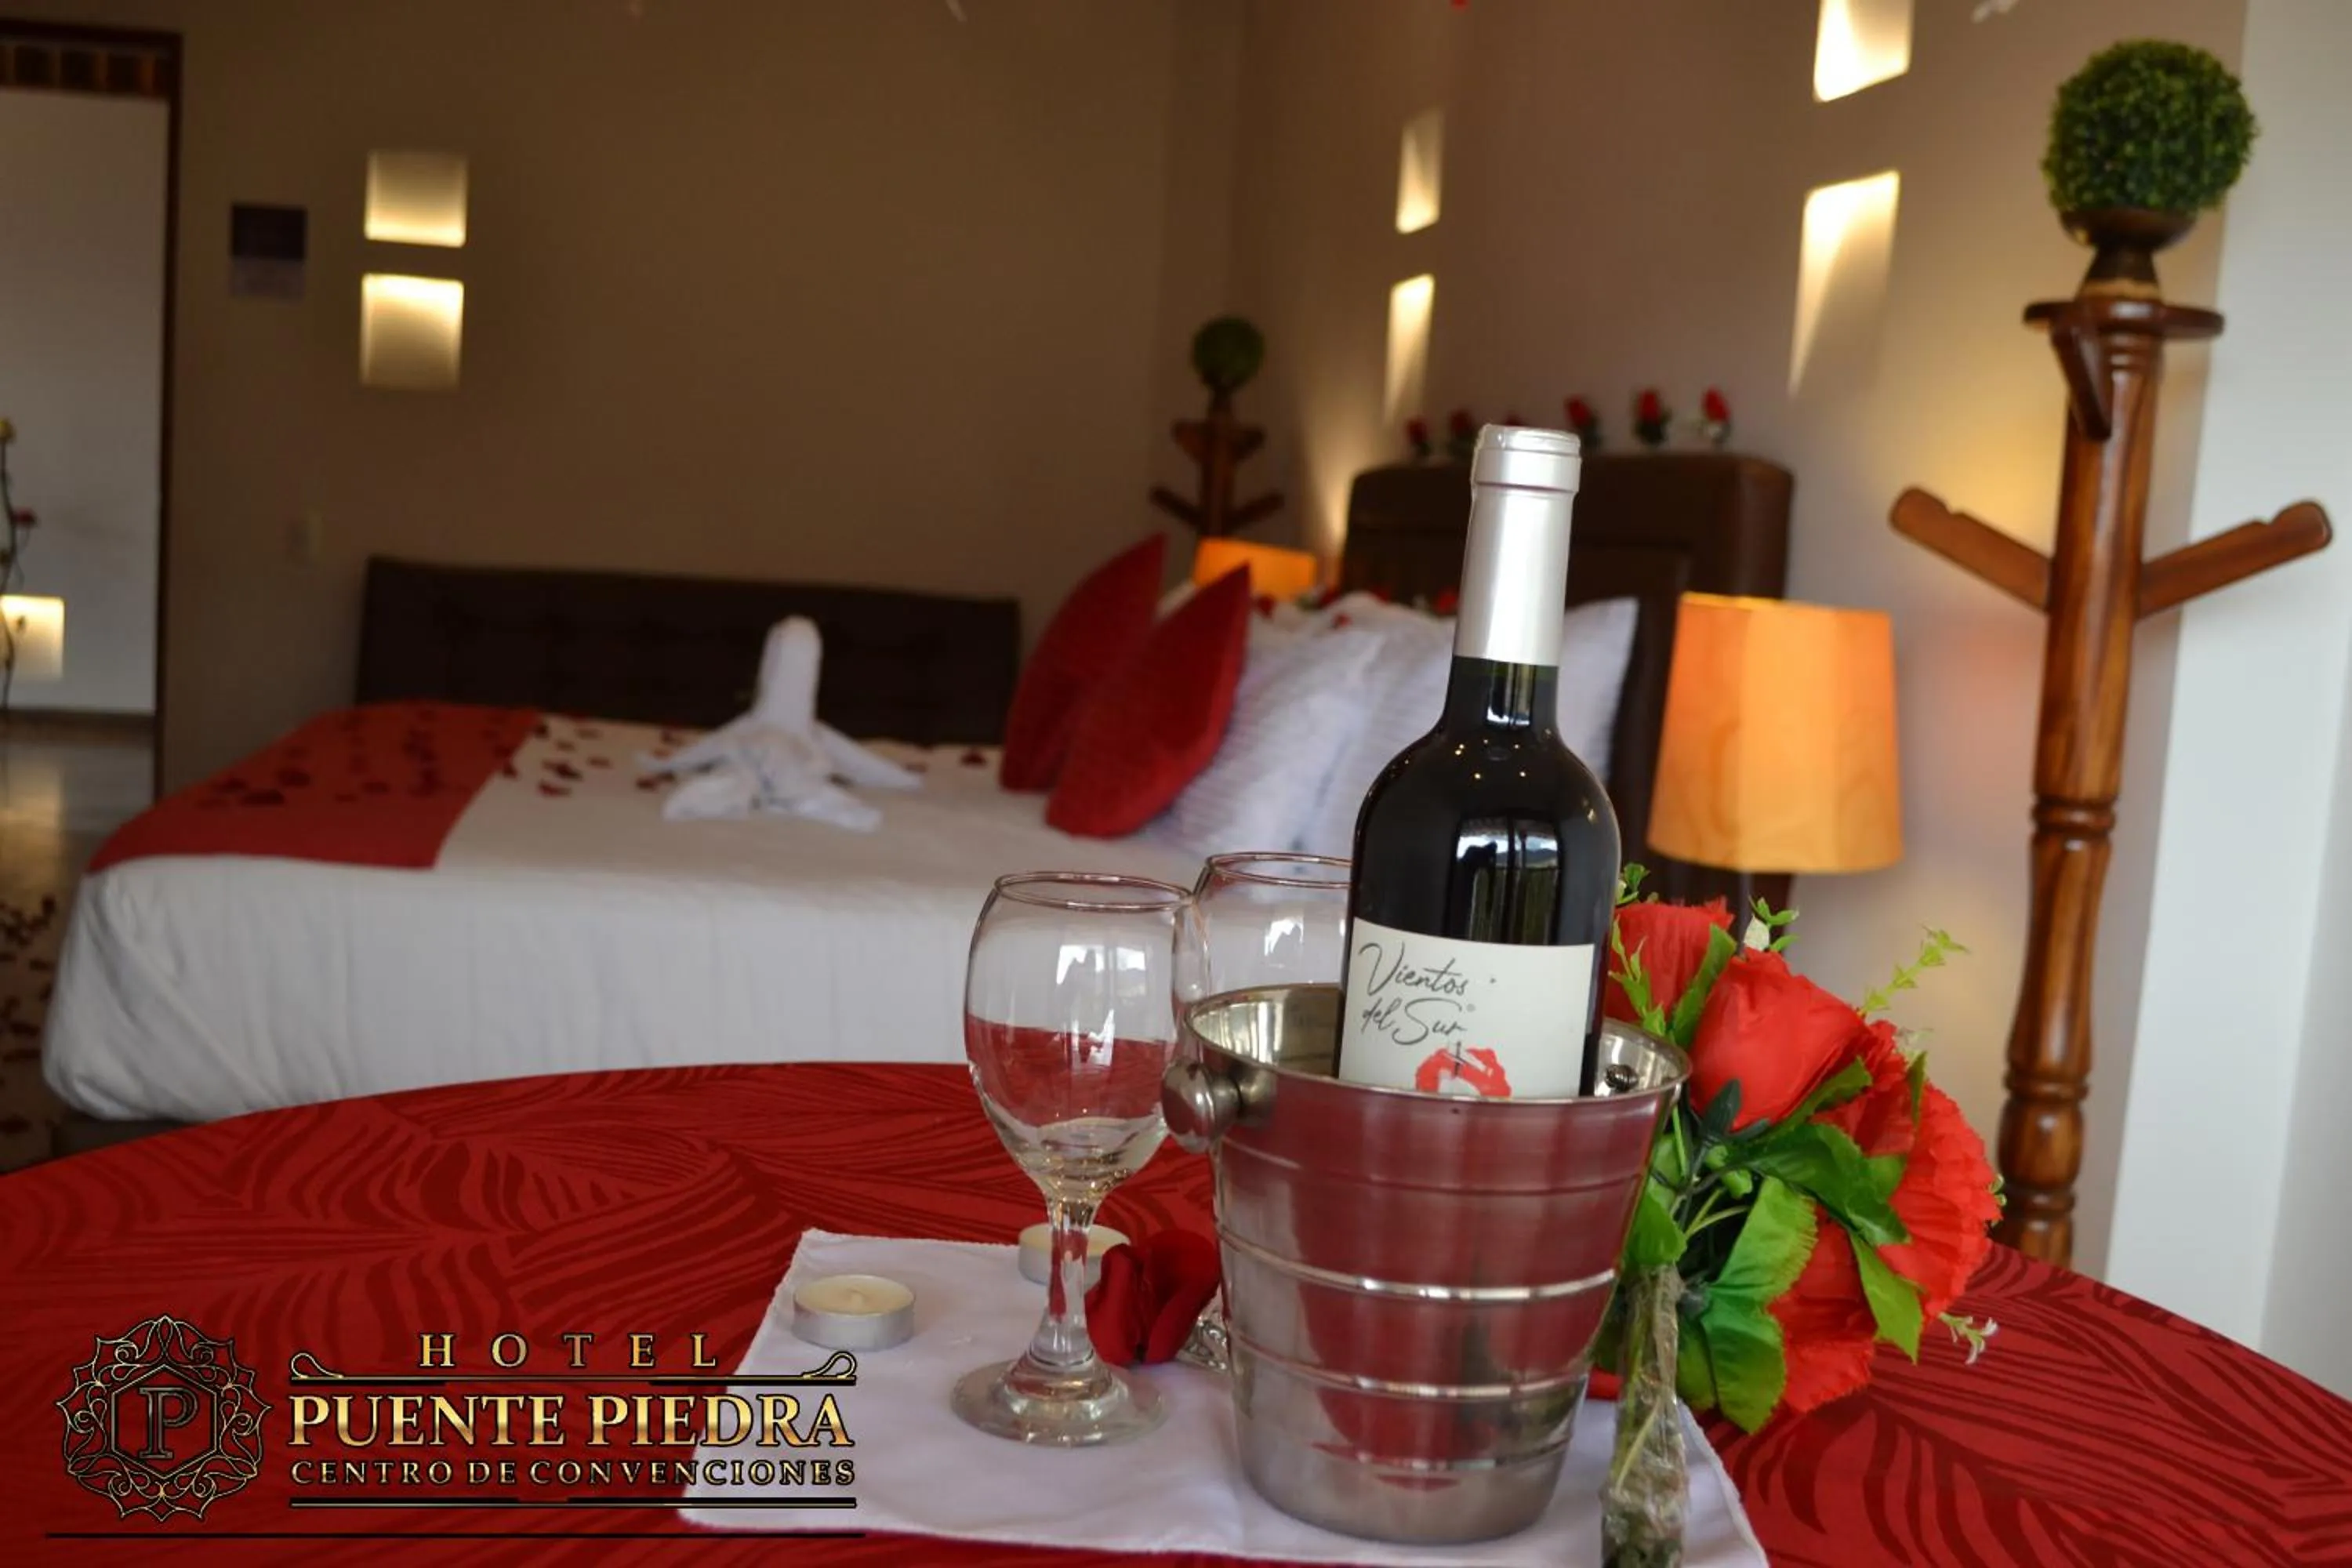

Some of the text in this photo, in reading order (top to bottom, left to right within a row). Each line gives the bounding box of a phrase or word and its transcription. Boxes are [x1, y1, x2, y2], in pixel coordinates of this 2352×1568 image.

[1357, 940, 1470, 996] Vientos
[1361, 996, 1468, 1046] del Sur
